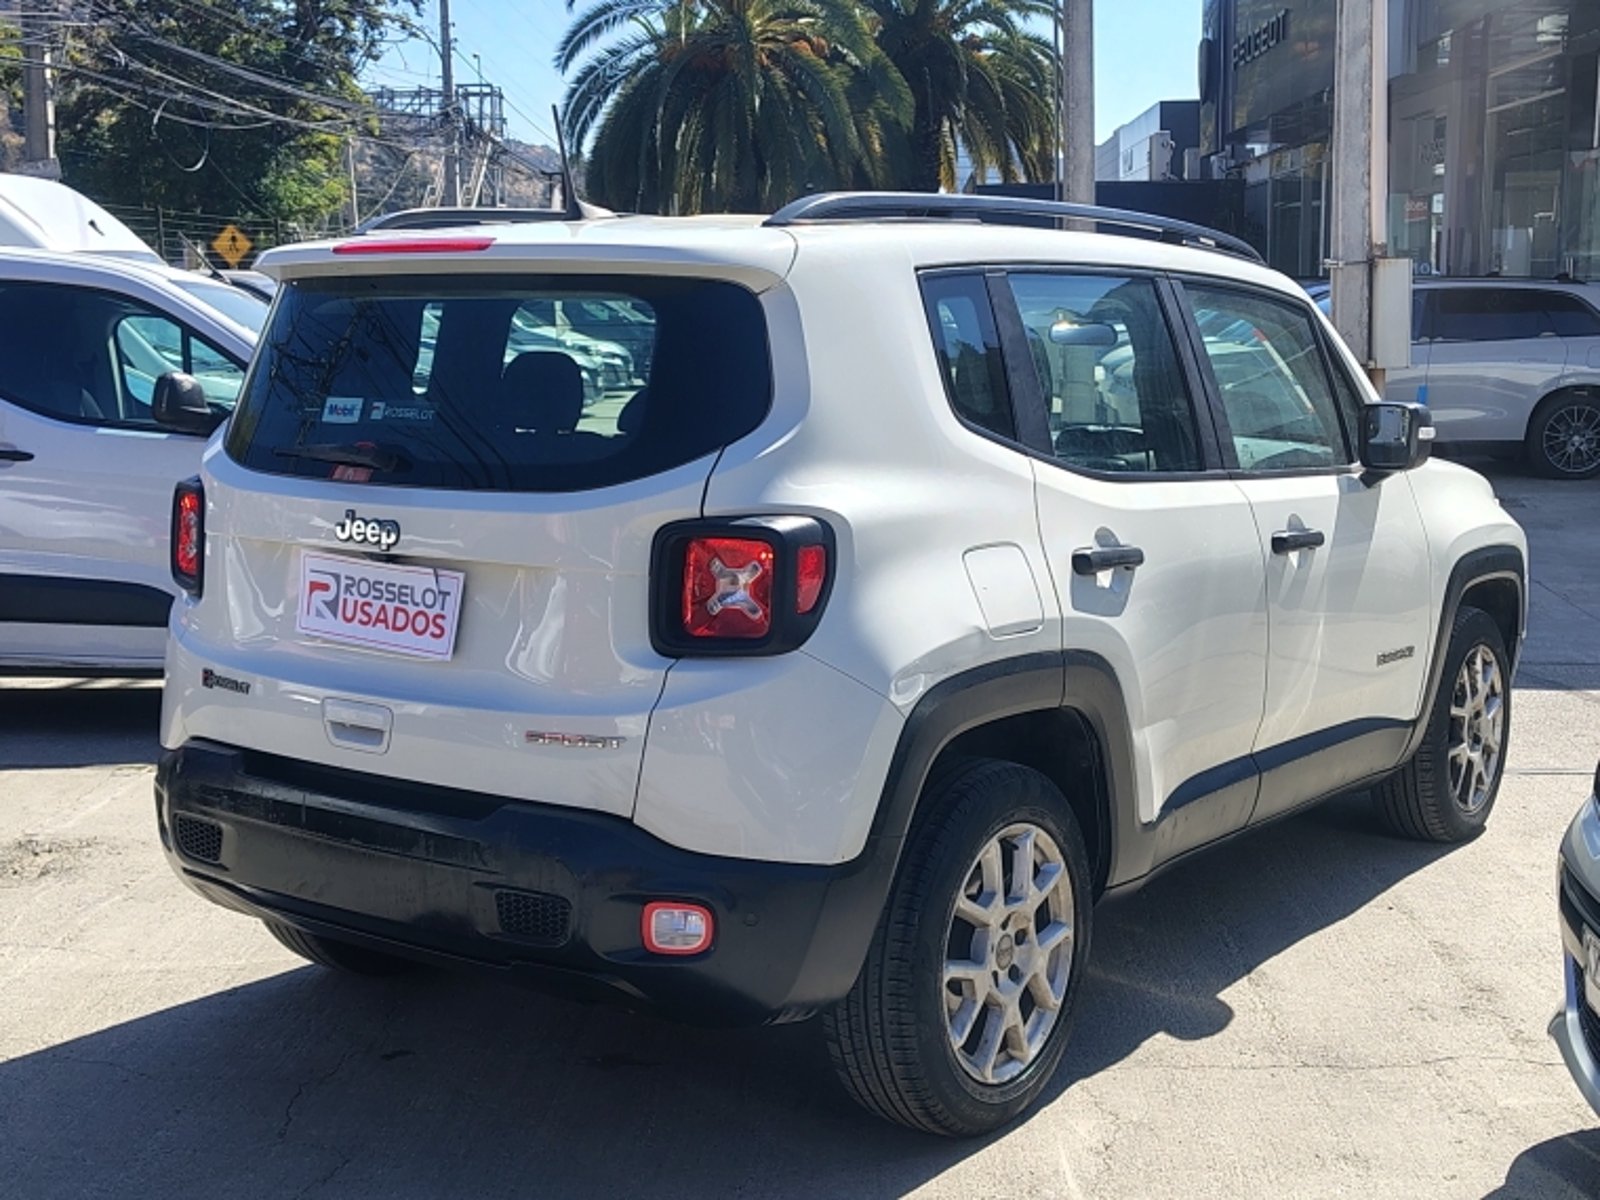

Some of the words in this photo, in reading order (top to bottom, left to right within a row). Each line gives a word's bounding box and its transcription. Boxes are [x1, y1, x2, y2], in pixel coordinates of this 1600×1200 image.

[1232, 8, 1289, 71] PEUGEOT
[335, 509, 400, 551] Jeep
[344, 575, 451, 611] ROSSELOT
[341, 598, 446, 639] USADOS
